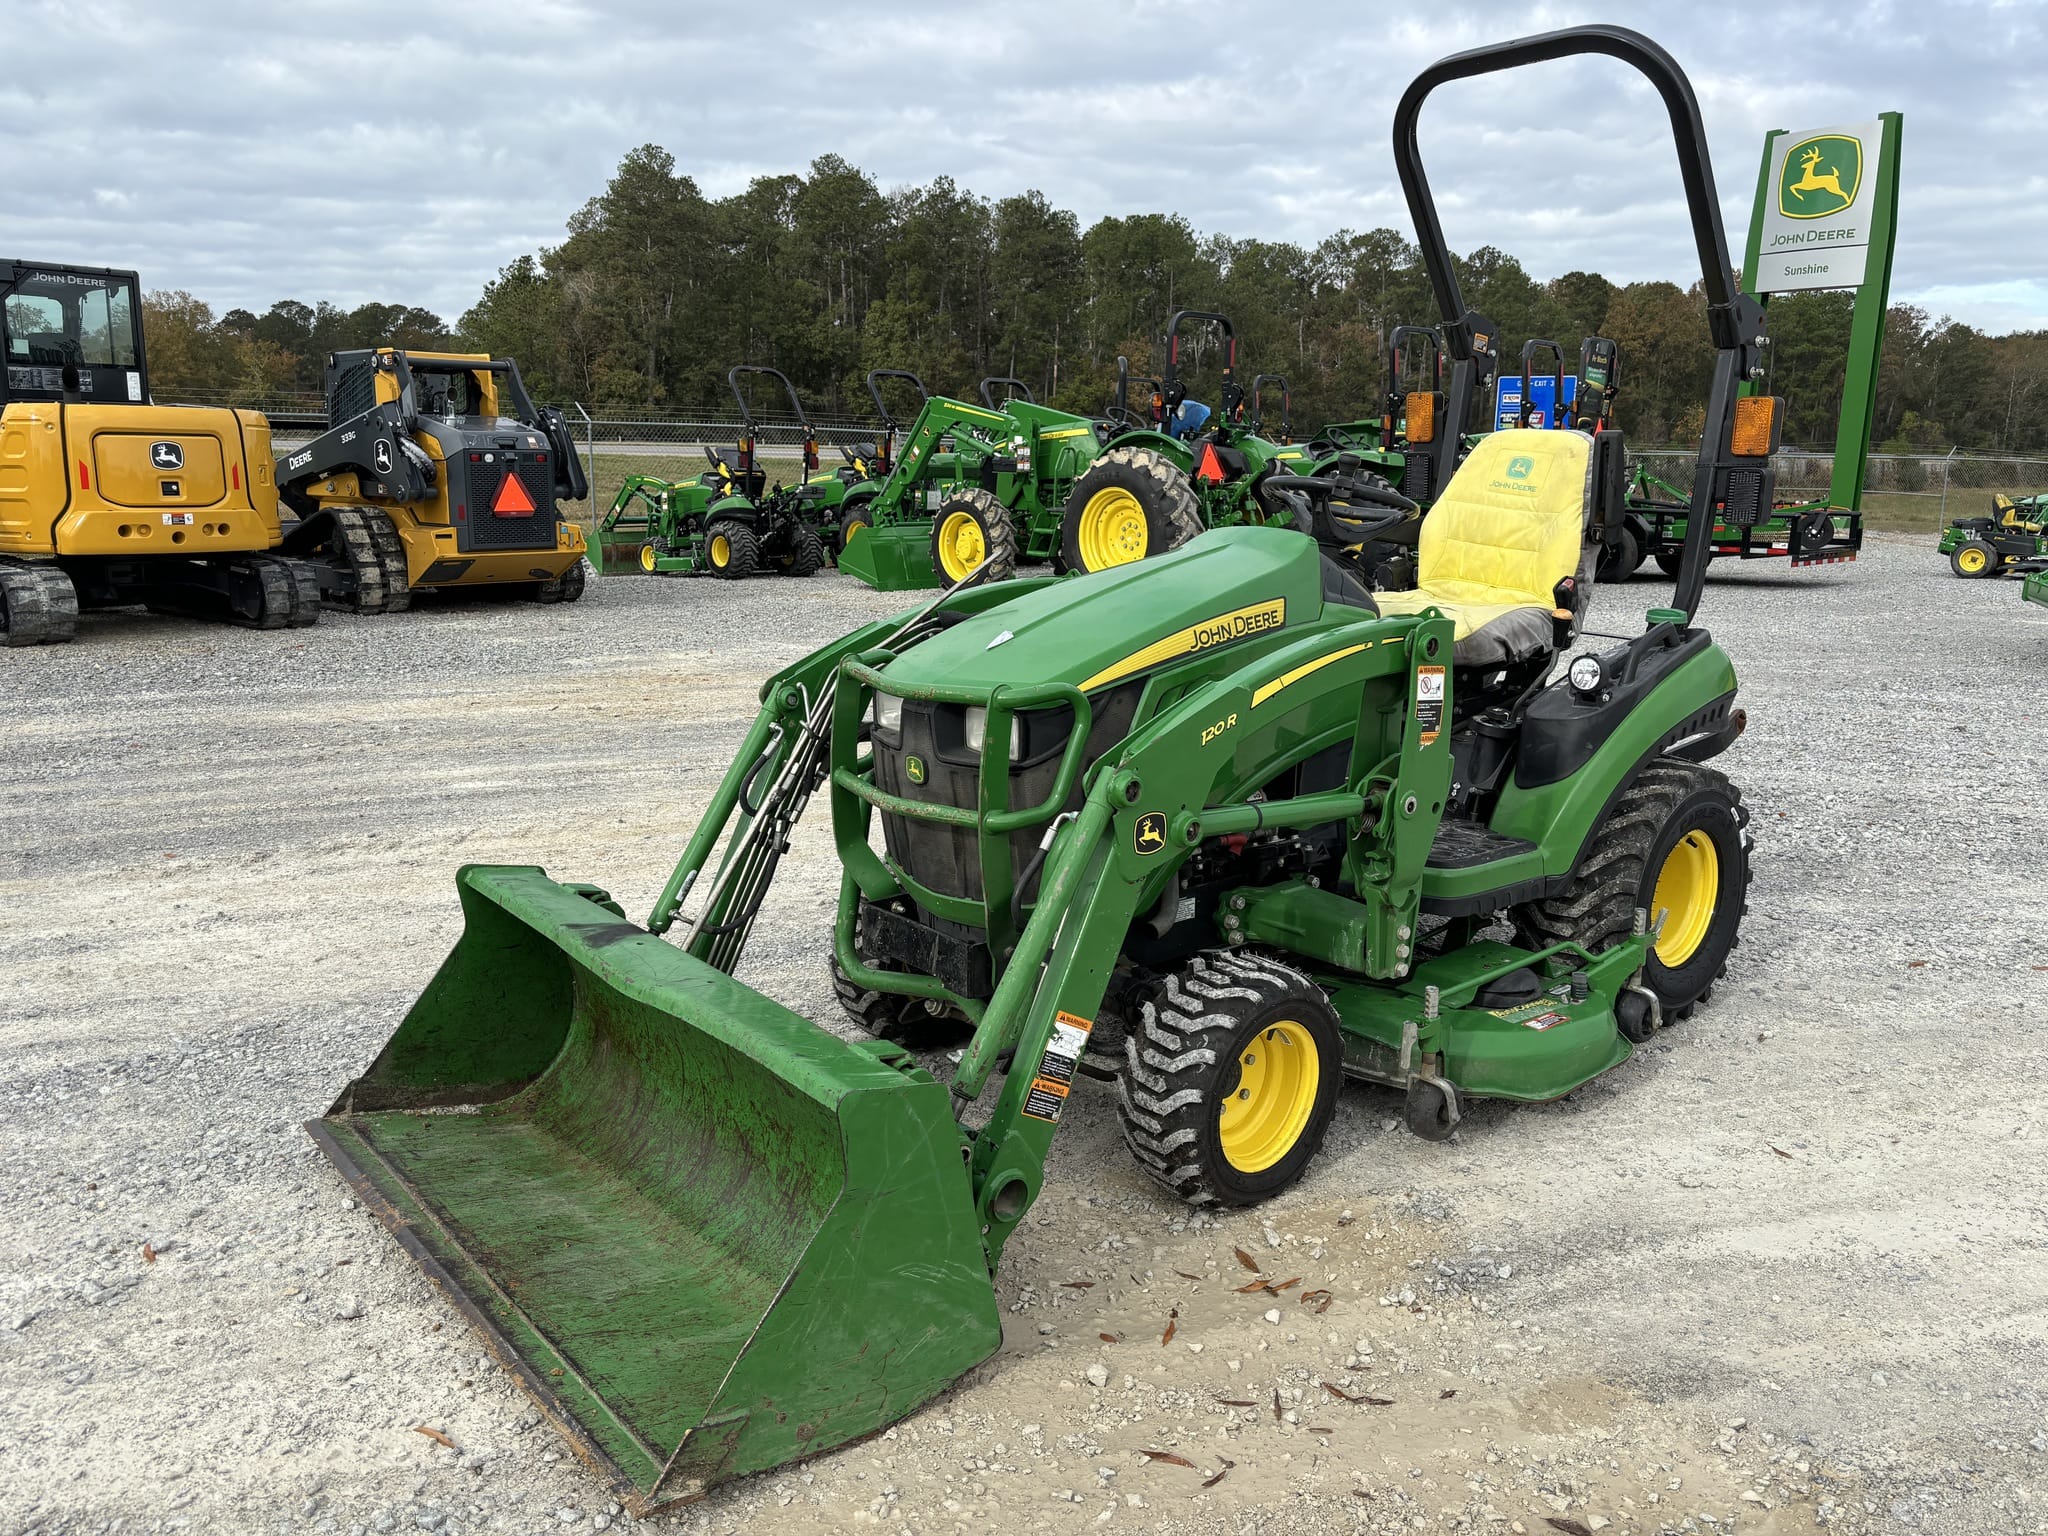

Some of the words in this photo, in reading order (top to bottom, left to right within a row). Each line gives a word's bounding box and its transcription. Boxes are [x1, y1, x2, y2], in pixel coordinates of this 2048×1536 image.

[1770, 233, 1805, 246] JOHN
[1806, 228, 1856, 242] DEERE
[1784, 264, 1829, 277] Sunshine
[32, 272, 65, 284] JOHN
[67, 275, 106, 287] DEERE
[340, 431, 356, 444] 333G
[288, 450, 313, 470] DEERE
[1489, 480, 1511, 489] JOHN
[1512, 482, 1538, 492] DEERE
[1190, 622, 1232, 650] JOHN
[1233, 610, 1279, 635] DEERE
[1423, 666, 1444, 674] WARNING
[1202, 720, 1225, 746] 120
[1227, 713, 1238, 729] R
[1066, 1015, 1088, 1029] WARNING
[1041, 1083, 1065, 1096] WARNING
